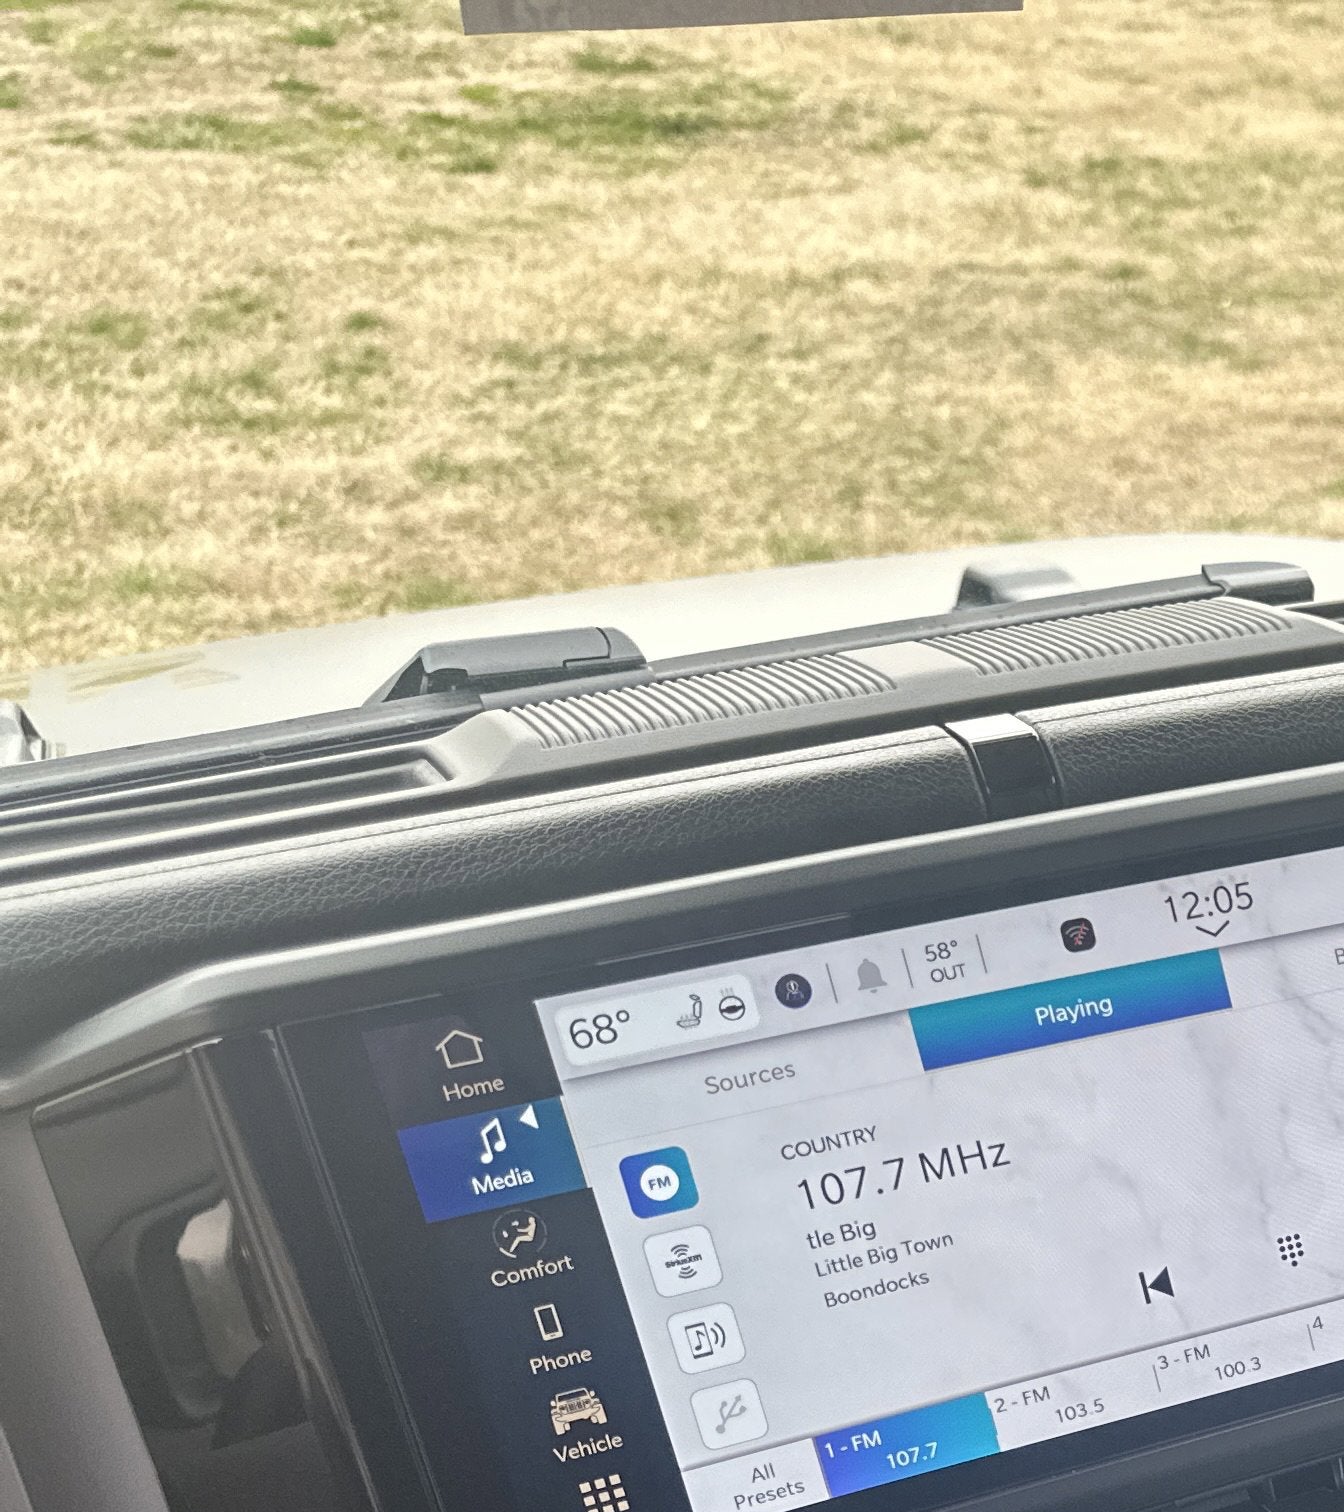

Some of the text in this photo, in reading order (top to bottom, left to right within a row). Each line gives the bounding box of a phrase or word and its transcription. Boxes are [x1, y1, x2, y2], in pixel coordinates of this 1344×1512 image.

[1164, 881, 1255, 924] 12:05
[924, 940, 958, 964] 58°
[930, 963, 966, 984] OUT
[1035, 994, 1114, 1027] Playing
[569, 1009, 630, 1050] 68°
[443, 1075, 505, 1101] Home
[704, 1061, 796, 1095] Sources
[781, 1126, 878, 1161] COUNTRY
[472, 1168, 534, 1196] Media
[648, 1174, 672, 1191] FM
[798, 1139, 1011, 1211] 107.7 MHz
[806, 1218, 877, 1251] tle Big
[814, 1231, 954, 1279] Little Big Town
[491, 1255, 574, 1289] Comfort
[823, 1269, 930, 1308] Boondocks
[1312, 1315, 1324, 1332] 4
[530, 1346, 592, 1375] Phone
[1157, 1344, 1212, 1370] 3 FM
[1213, 1355, 1262, 1380] 100.3
[994, 1385, 1051, 1415] 2 FM
[1055, 1398, 1106, 1424] 103.5
[553, 1433, 623, 1464] Vehicle
[825, 1430, 883, 1460] 1 FM
[885, 1441, 939, 1470] 107.7
[750, 1463, 776, 1484] All
[733, 1479, 806, 1511] Presets
